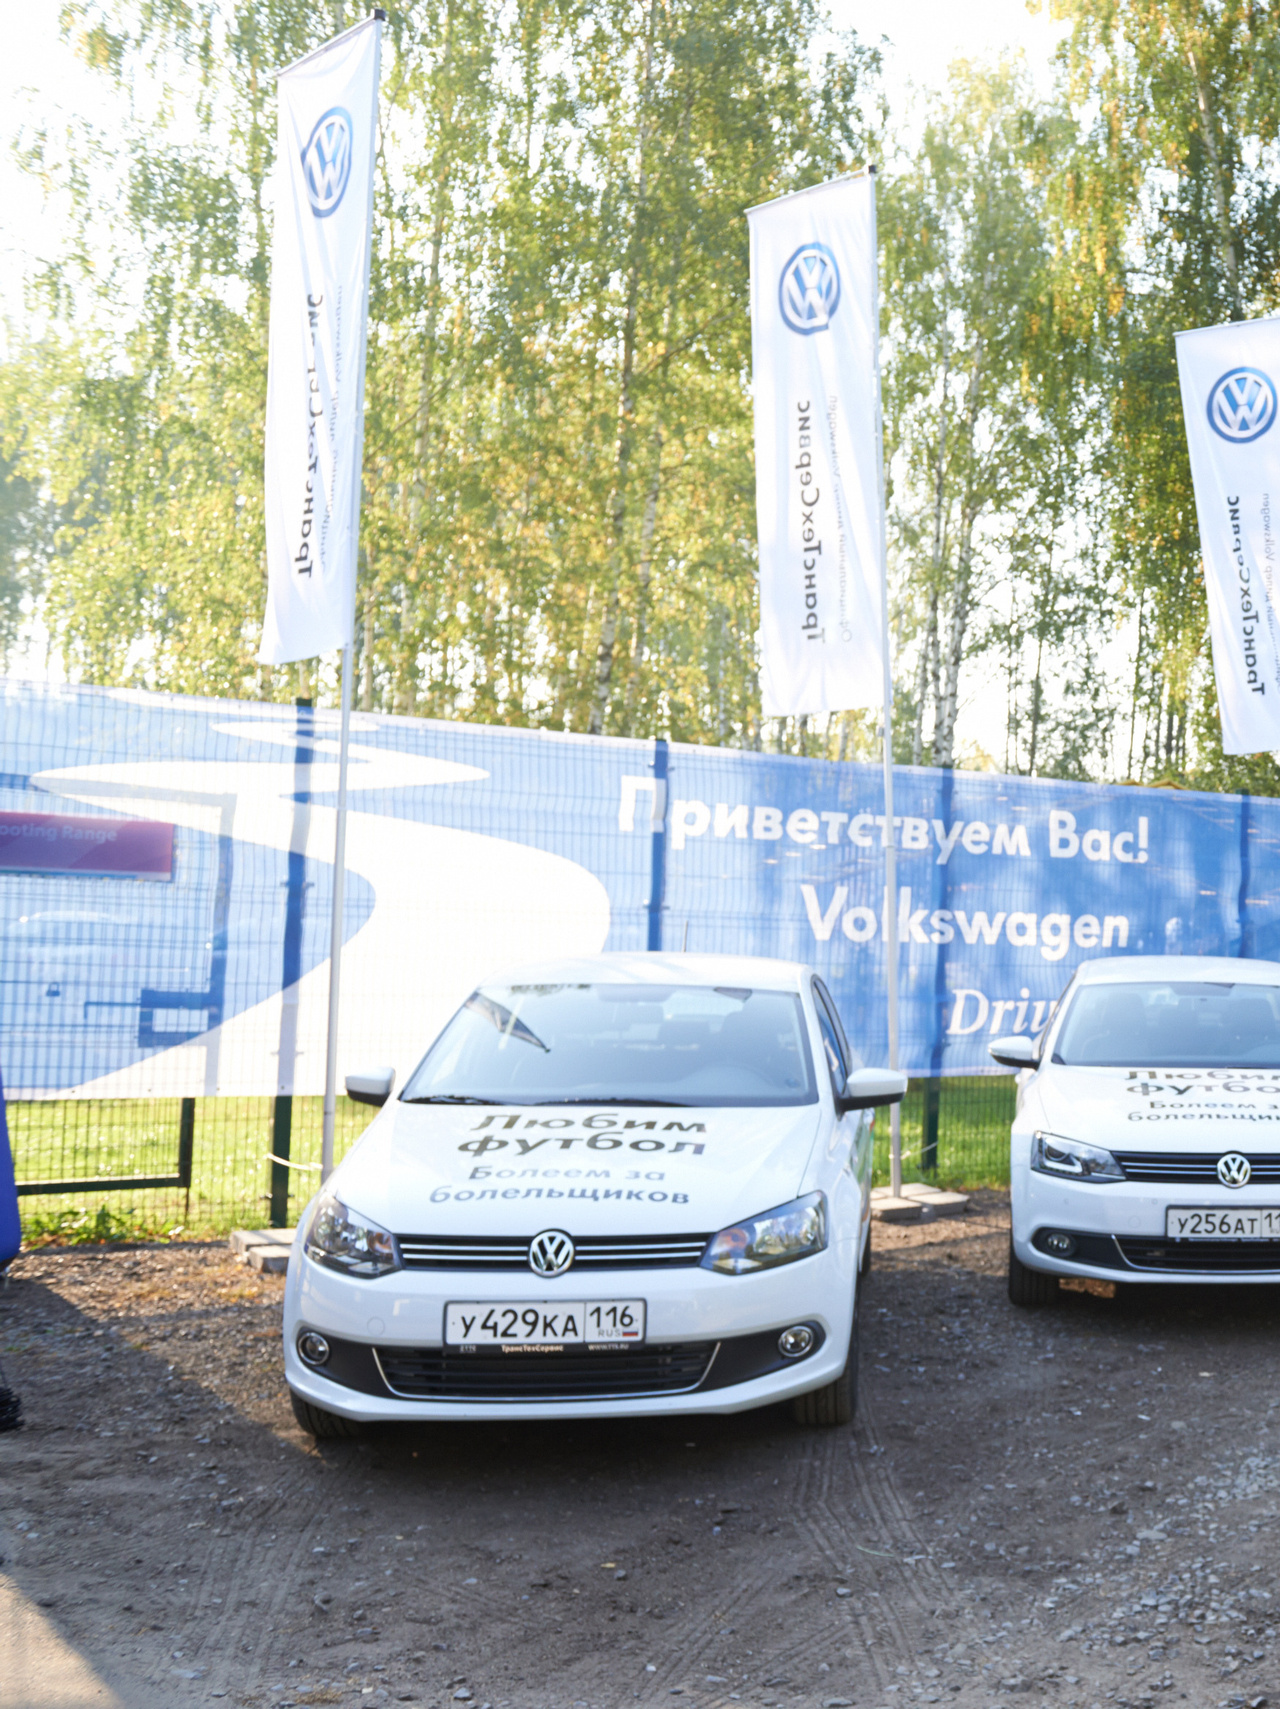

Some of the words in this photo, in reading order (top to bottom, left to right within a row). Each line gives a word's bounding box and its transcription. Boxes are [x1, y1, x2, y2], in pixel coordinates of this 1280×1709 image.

[618, 775, 1031, 865] Приветствуем
[1049, 810, 1149, 863] Вас!
[0, 823, 57, 841] ooting
[62, 825, 117, 844] Range
[801, 884, 1129, 961] Volkswagen
[946, 987, 1058, 1034] Driv
[1150, 1101, 1256, 1109] Болеем
[470, 1113, 707, 1133] Любим
[457, 1131, 706, 1157] футбол
[468, 1166, 611, 1180] Болеем
[625, 1169, 665, 1181] за
[429, 1185, 689, 1204] болельщиков
[589, 1306, 635, 1328] 116
[598, 1329, 621, 1337] RUS
